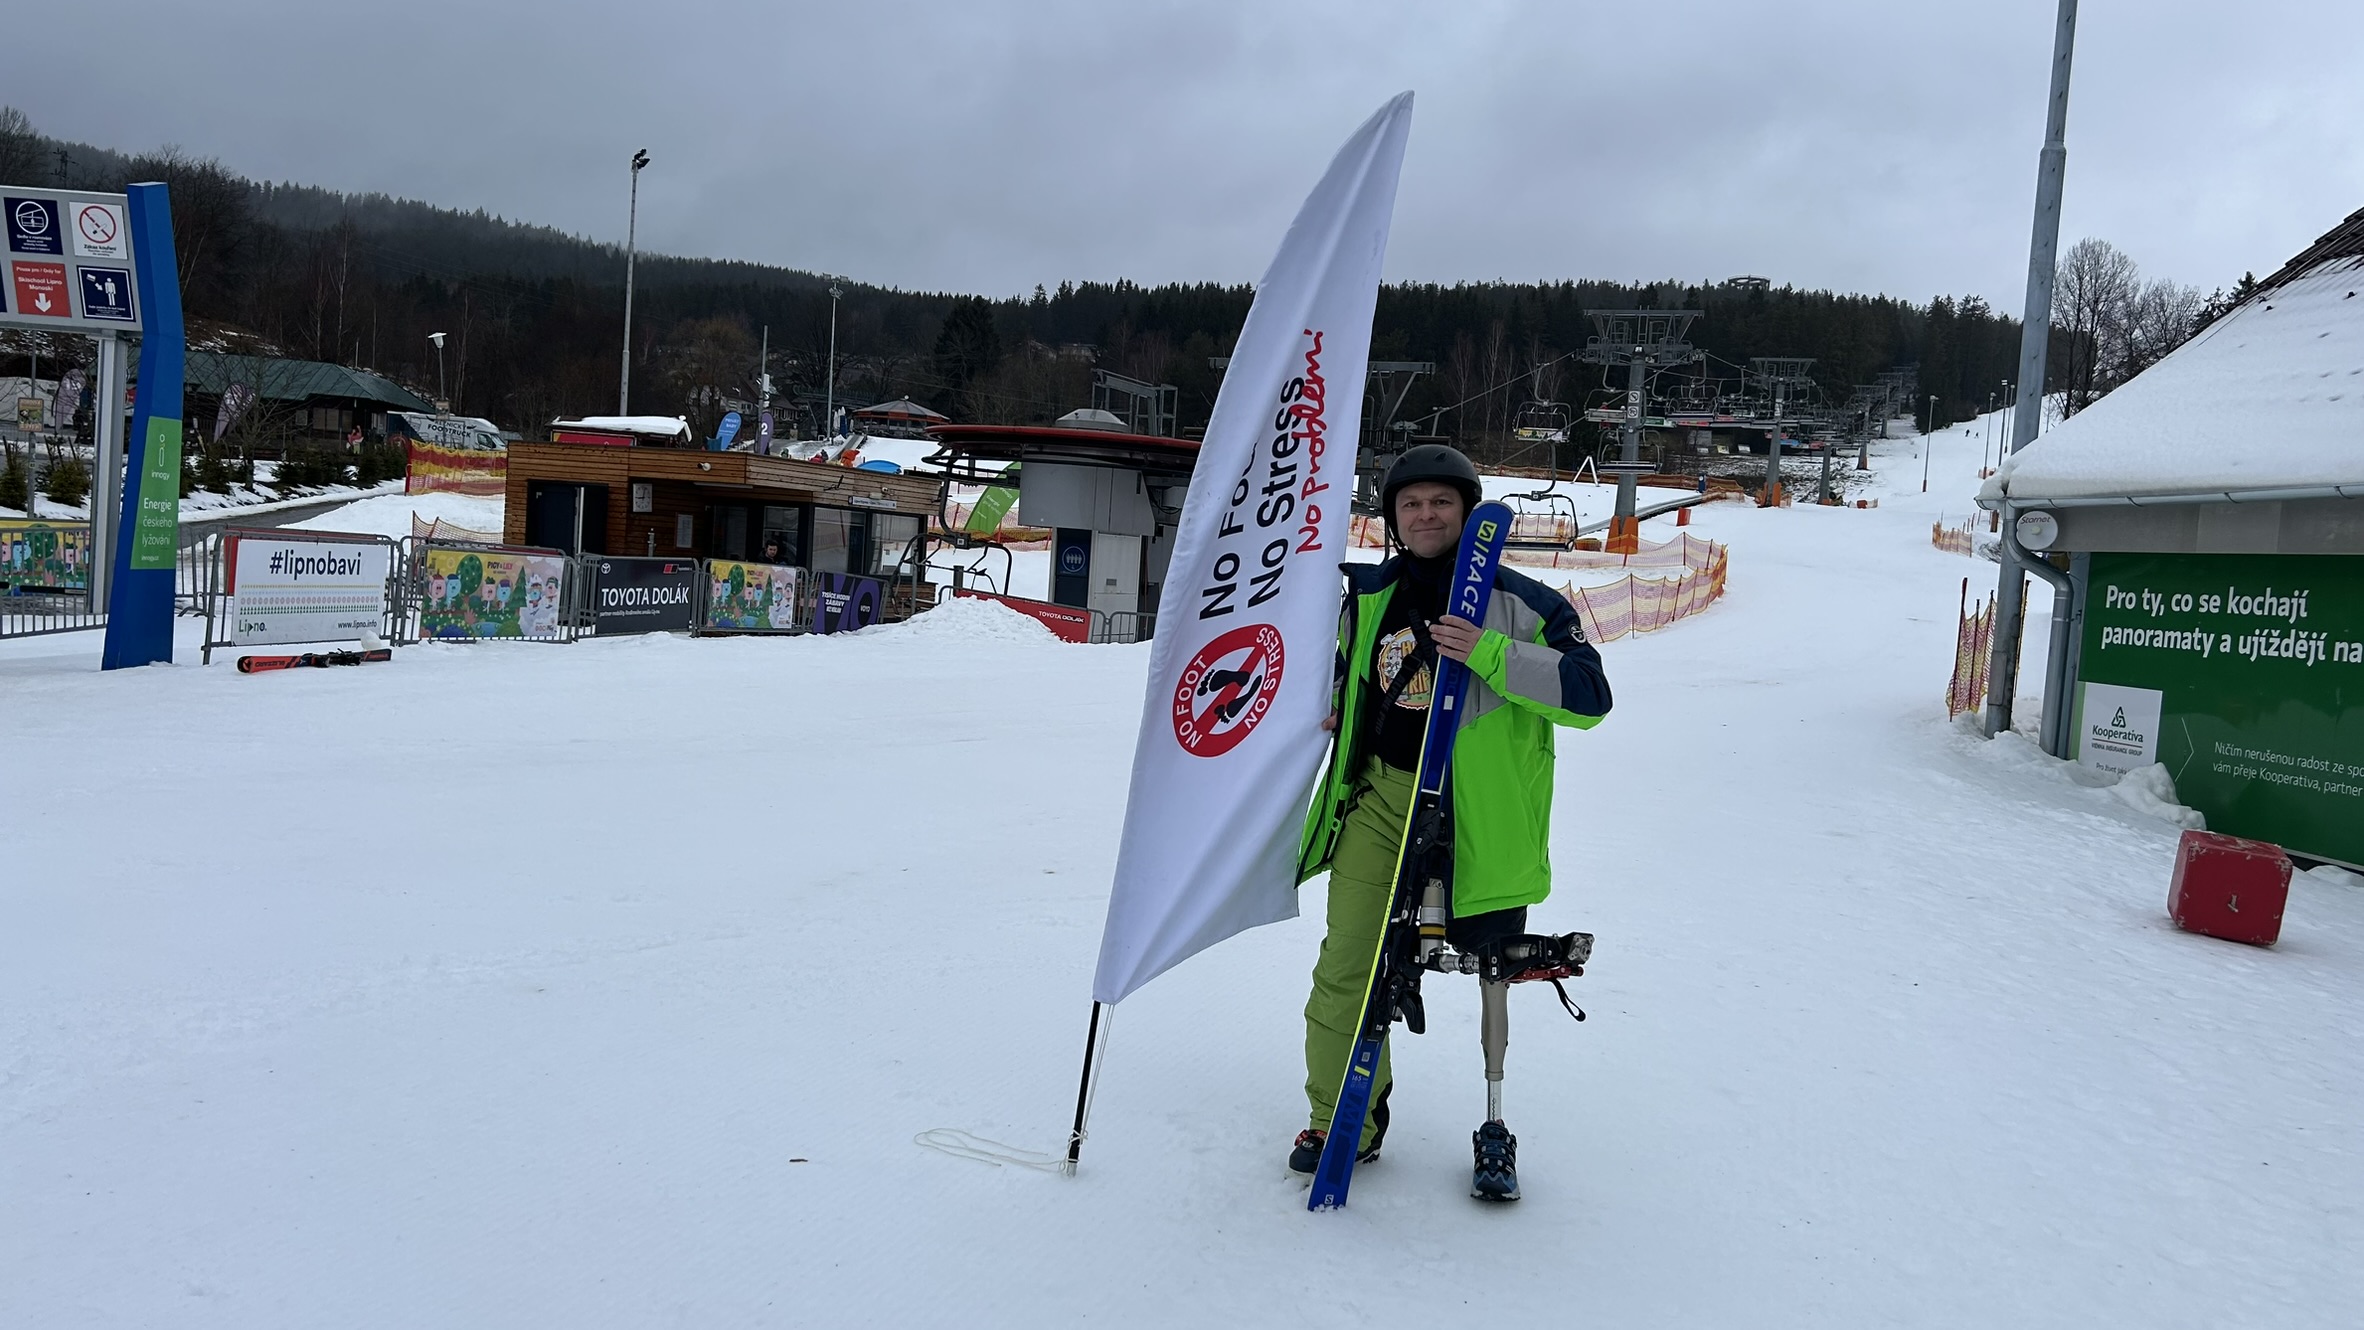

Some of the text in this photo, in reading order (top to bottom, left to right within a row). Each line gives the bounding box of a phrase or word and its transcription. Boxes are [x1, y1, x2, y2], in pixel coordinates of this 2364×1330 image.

[18, 276, 45, 284] Skischool
[761, 422, 768, 435] 2
[151, 470, 170, 480] innogy
[143, 497, 172, 512] Energie
[1247, 377, 1305, 608] No Stress
[142, 516, 173, 528] českého
[1295, 504, 1323, 554] No
[141, 533, 171, 547] lyžování
[269, 549, 362, 581] #lipnobavi
[601, 582, 690, 607] TOYOTA DOLÁK
[1199, 552, 1241, 620] No
[1039, 610, 1061, 620] TOYOTA
[2105, 585, 2309, 624] Pro ty, co se kochají
[337, 620, 378, 630] www.lipno.info
[2100, 625, 2364, 667] panoramaty a ujíždějí na
[1244, 627, 1281, 730] NO STRESS
[1176, 655, 1208, 749] NO FOOT
[2092, 724, 2144, 743] Kooperativa
[2128, 748, 2143, 757] GROUP
[2214, 741, 2242, 758] Ničím
[2244, 748, 2295, 766] nerušenou
[2296, 755, 2330, 772] radost
[2332, 763, 2345, 774] ze
[2212, 760, 2363, 797] vám přeje Kooperativa, partner
